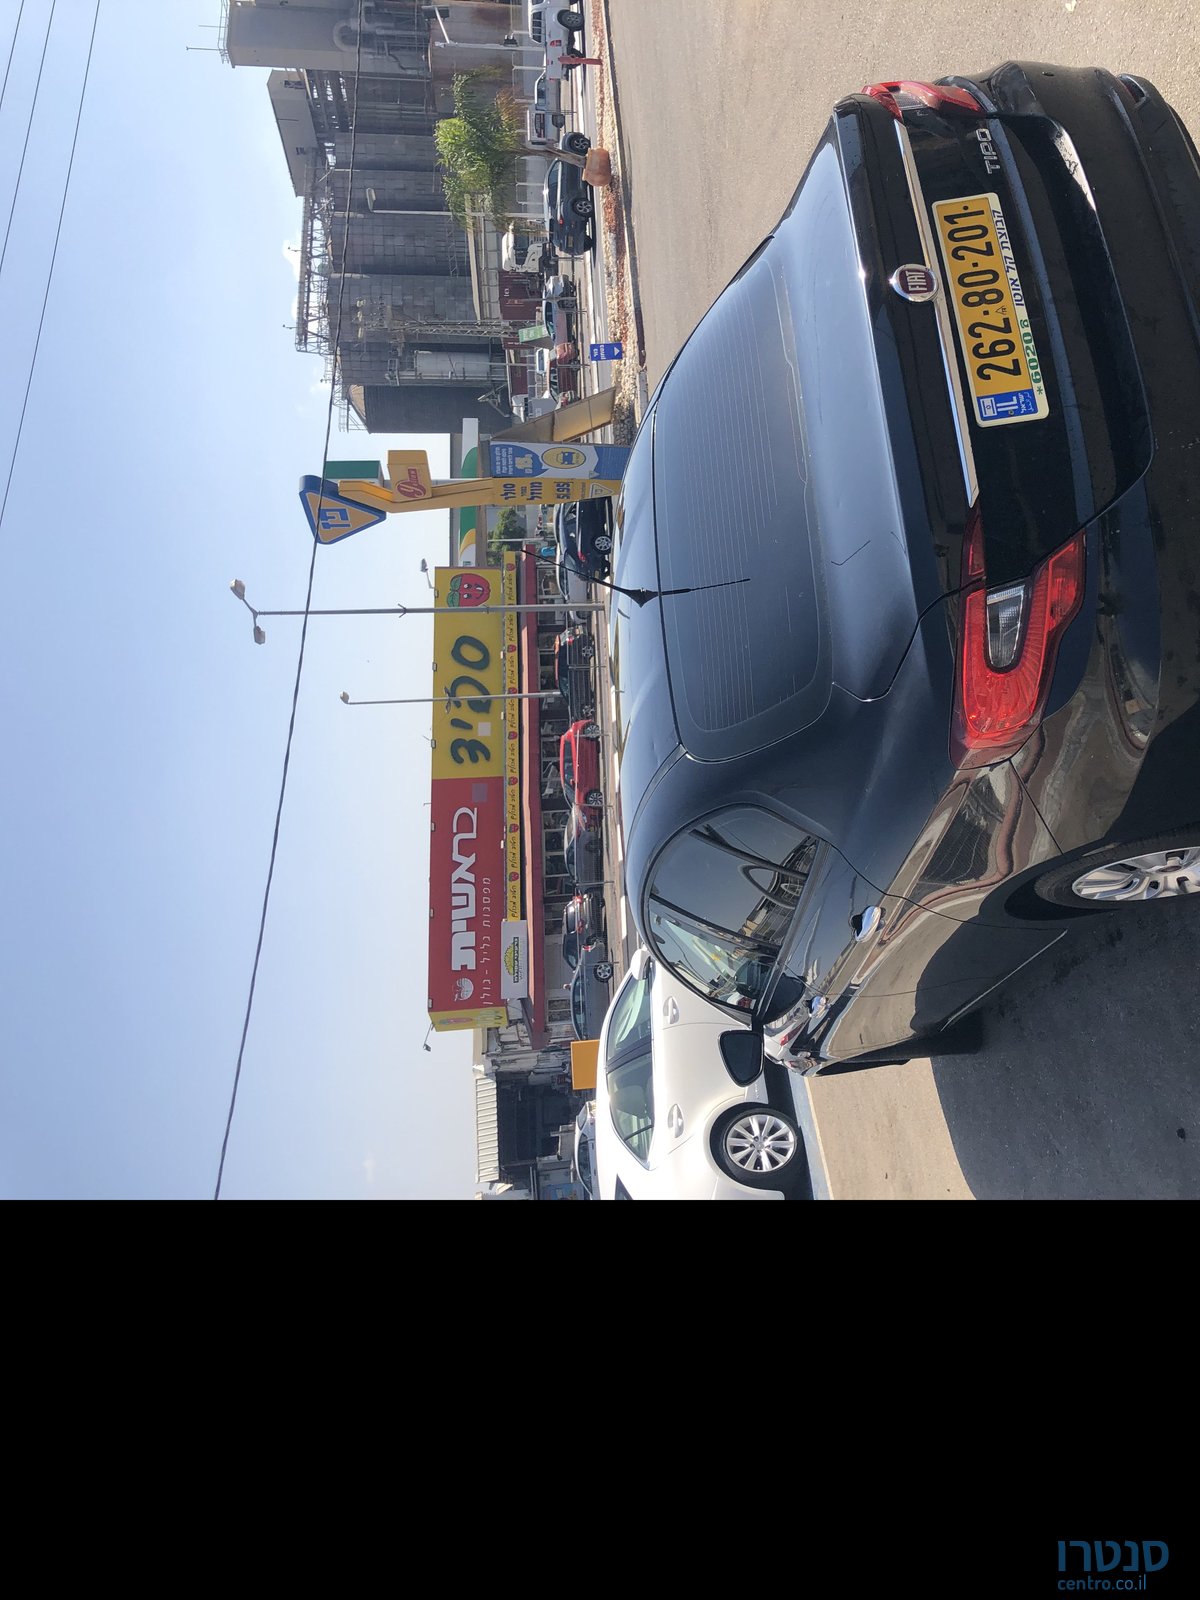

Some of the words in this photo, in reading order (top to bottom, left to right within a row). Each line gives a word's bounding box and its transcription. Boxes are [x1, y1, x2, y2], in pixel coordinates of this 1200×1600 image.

[975, 128, 1000, 174] TIPO
[992, 210, 1011, 250] קבוצת
[1000, 256, 1016, 272] קל
[905, 270, 928, 291] FIAT
[1008, 278, 1024, 307] אוטו
[996, 396, 1018, 411] IL
[500, 484, 516, 500] סולר
[526, 482, 542, 500] מוזל
[318, 508, 351, 530] פז
[451, 806, 478, 971] בראשית
[482, 877, 492, 928] מפסגות
[480, 936, 491, 963] גליל
[480, 979, 493, 1005] גולן
